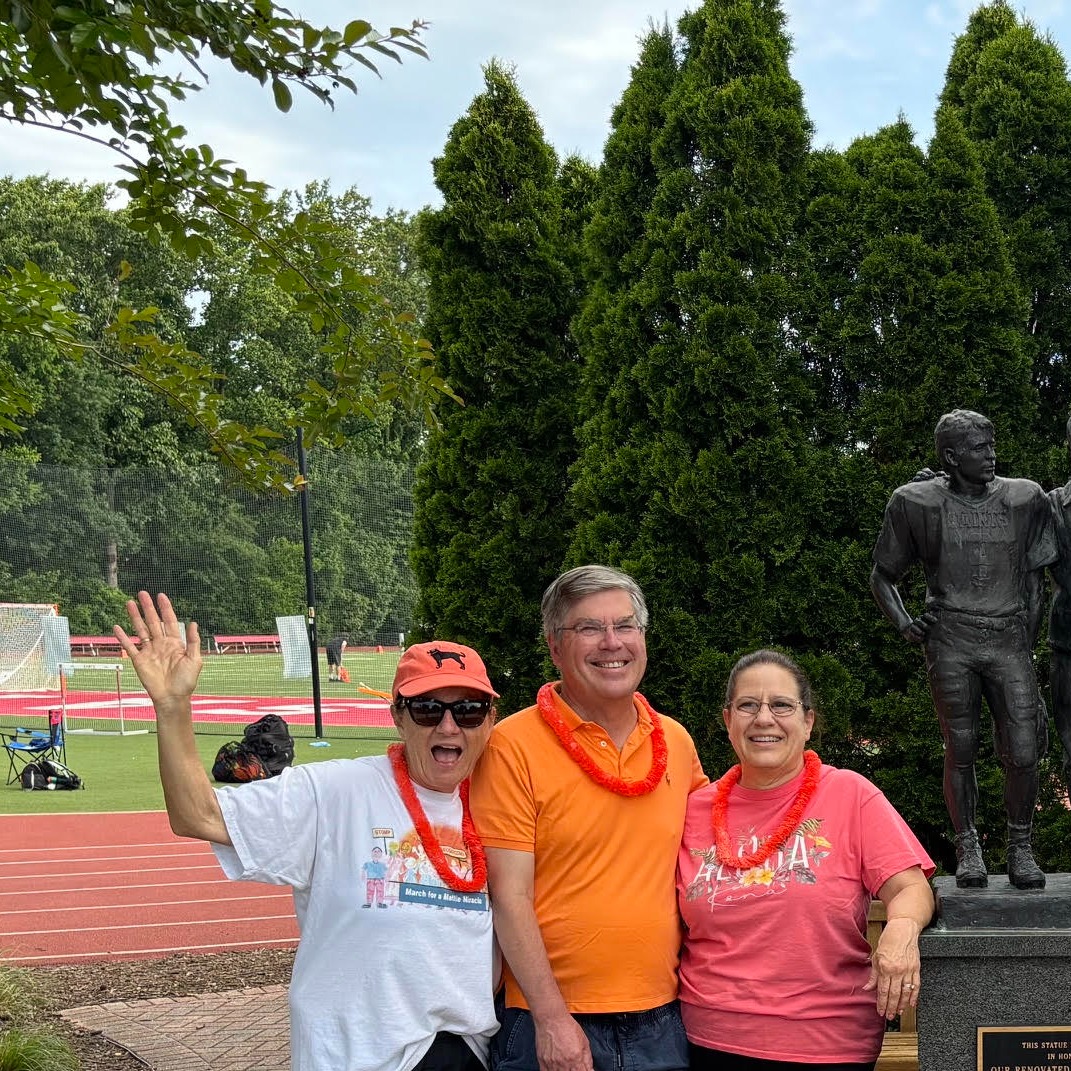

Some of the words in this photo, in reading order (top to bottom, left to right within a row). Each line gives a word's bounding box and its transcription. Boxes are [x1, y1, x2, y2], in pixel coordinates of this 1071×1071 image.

[405, 888, 427, 897] March
[1021, 1041, 1039, 1049] THIS
[1041, 1041, 1068, 1049] STATUE
